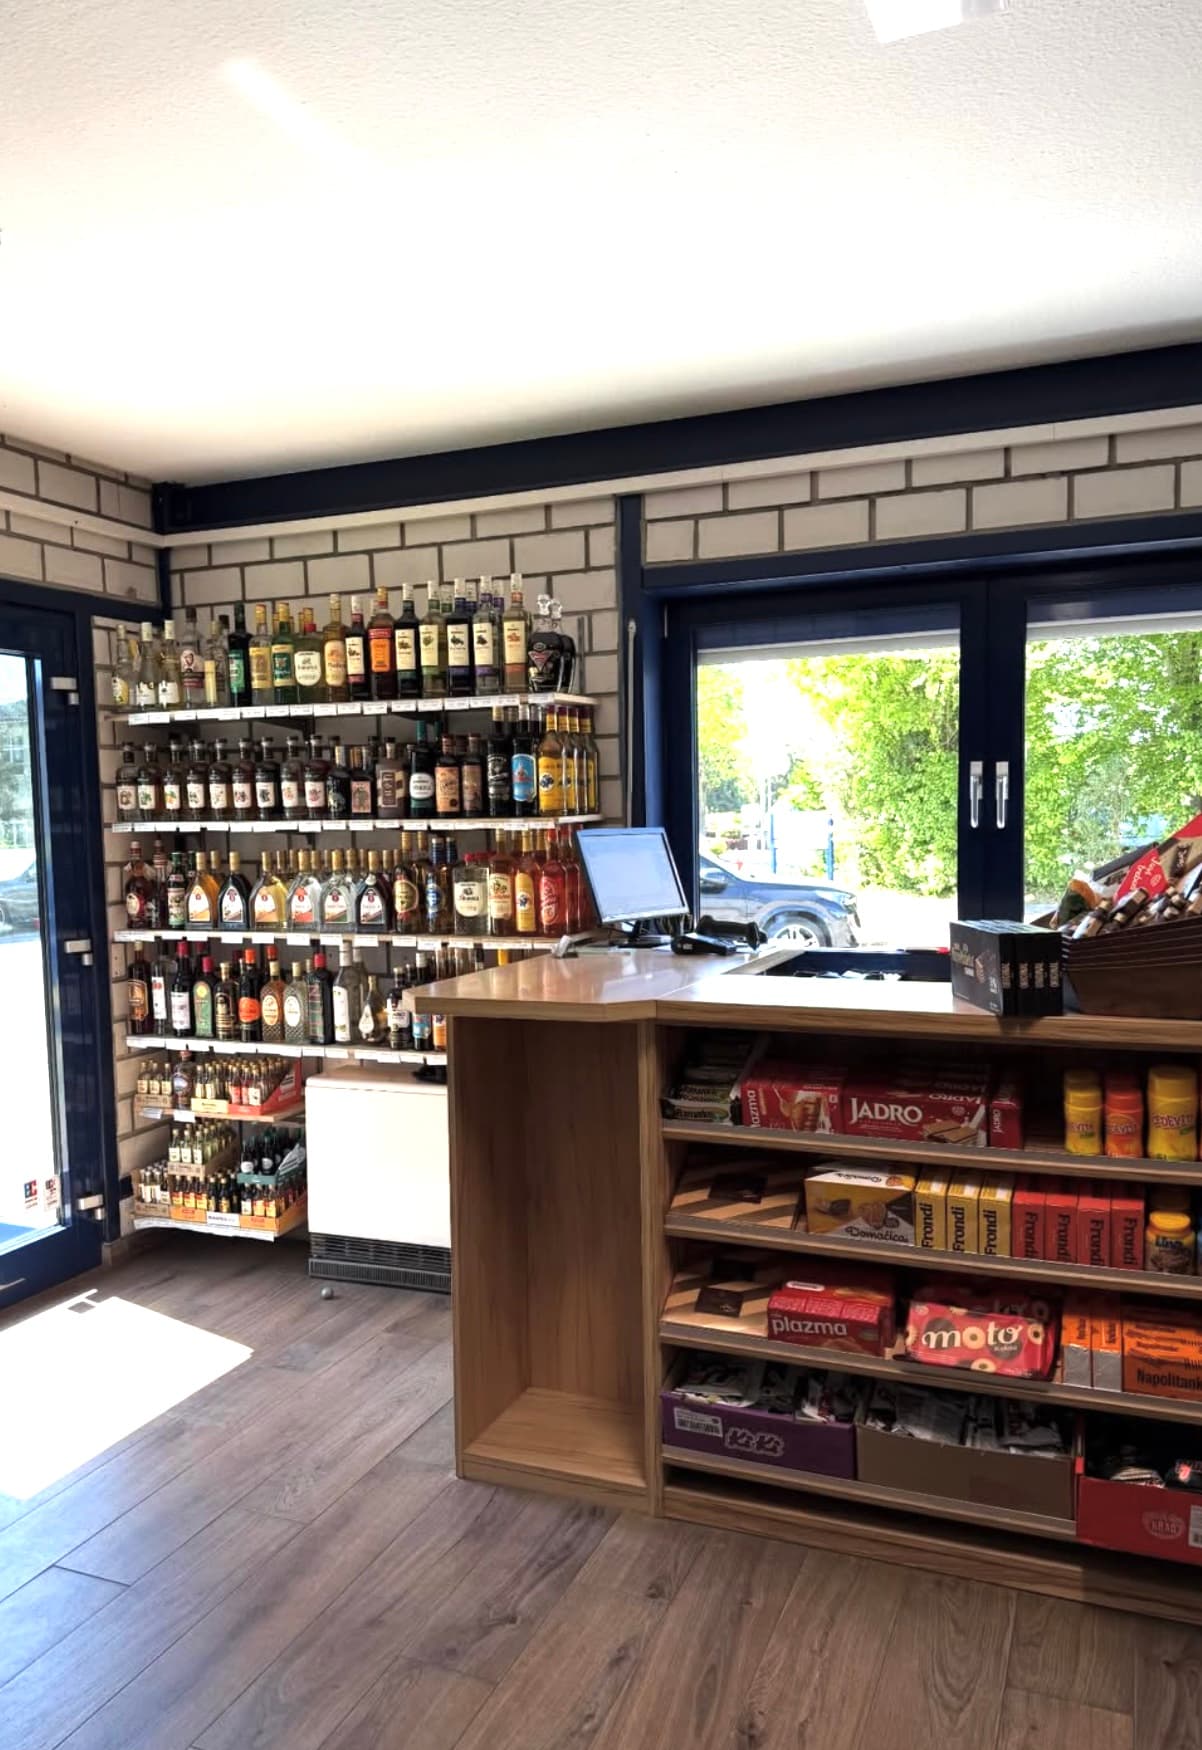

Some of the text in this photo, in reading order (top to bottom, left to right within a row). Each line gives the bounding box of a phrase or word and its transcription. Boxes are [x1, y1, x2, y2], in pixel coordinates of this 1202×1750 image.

[747, 1090, 760, 1128] lazma
[849, 1097, 923, 1127] JADRO
[919, 1202, 934, 1248] Frondi
[951, 1206, 966, 1251] Frondi
[982, 1209, 998, 1255] Frondi
[1123, 1216, 1138, 1265] Frondi
[772, 1316, 848, 1336] plazma
[921, 1321, 1024, 1350] moto
